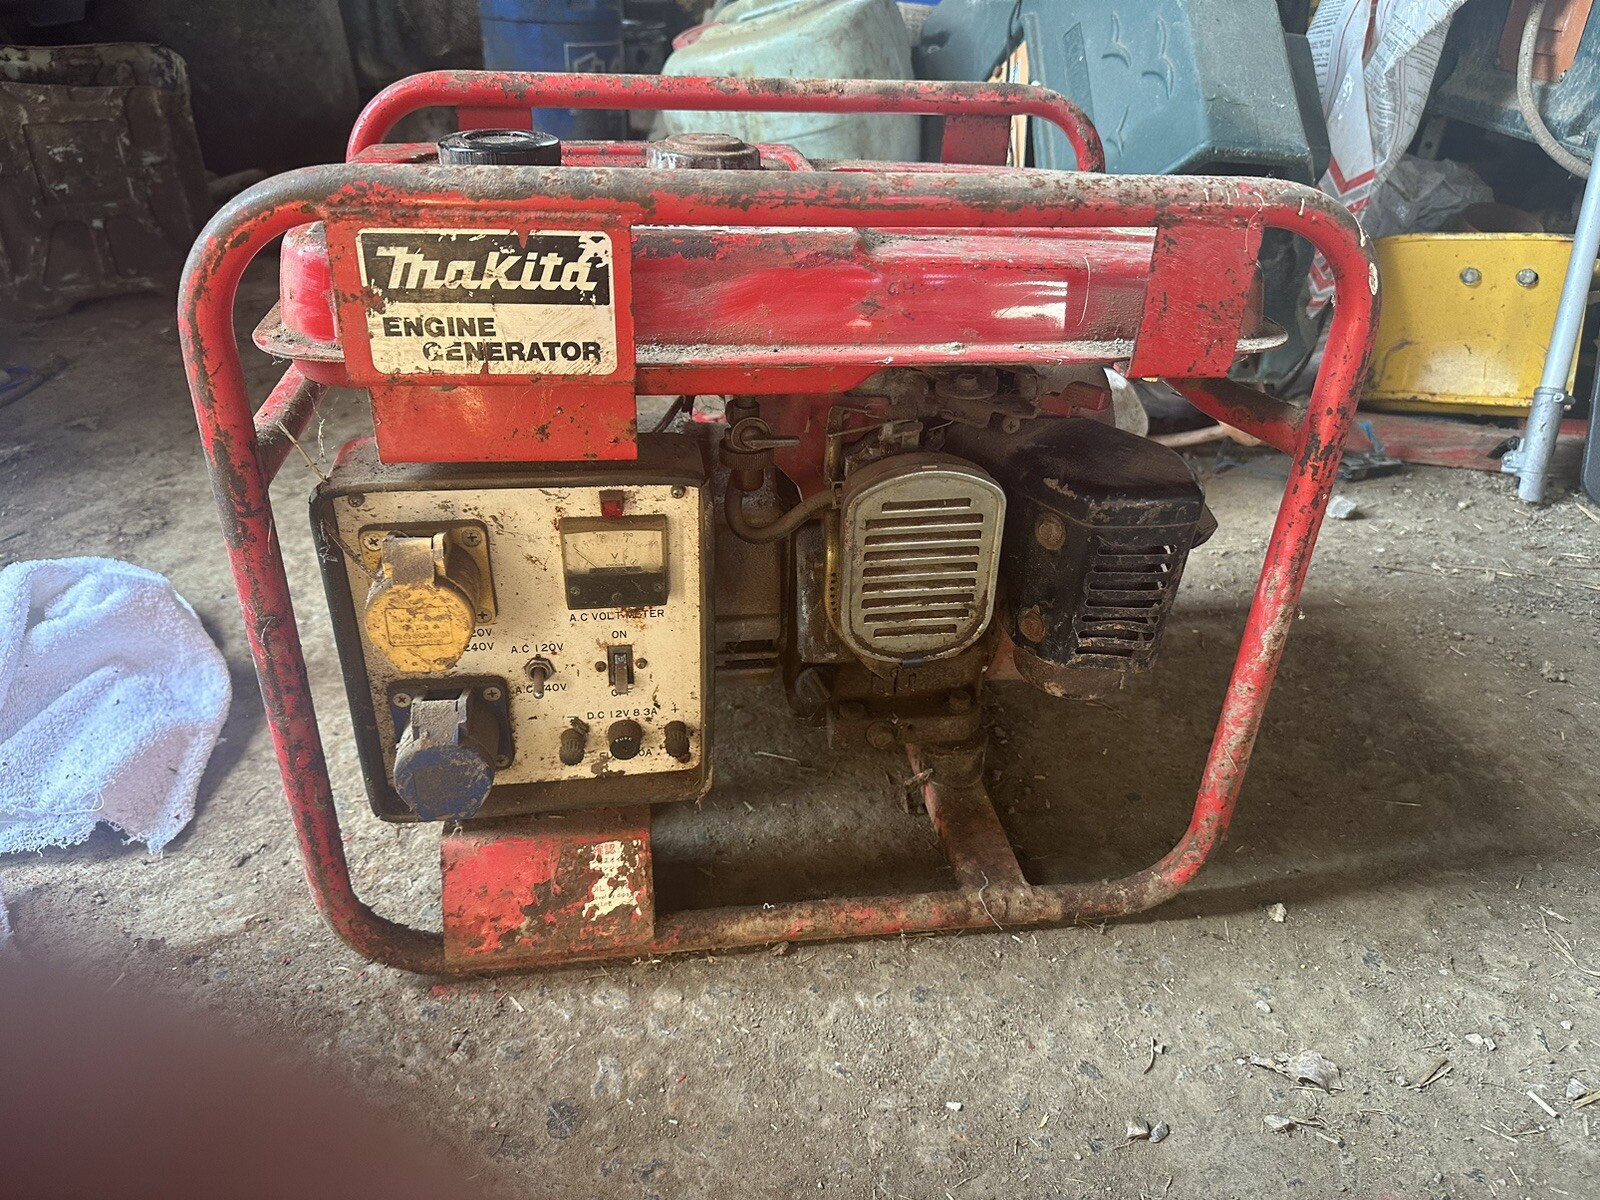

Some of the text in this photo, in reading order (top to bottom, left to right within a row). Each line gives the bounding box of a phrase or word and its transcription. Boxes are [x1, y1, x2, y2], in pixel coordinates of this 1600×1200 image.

[382, 316, 497, 337] ENGINE
[422, 341, 602, 363] GENERATOR
[611, 630, 627, 639] ON
